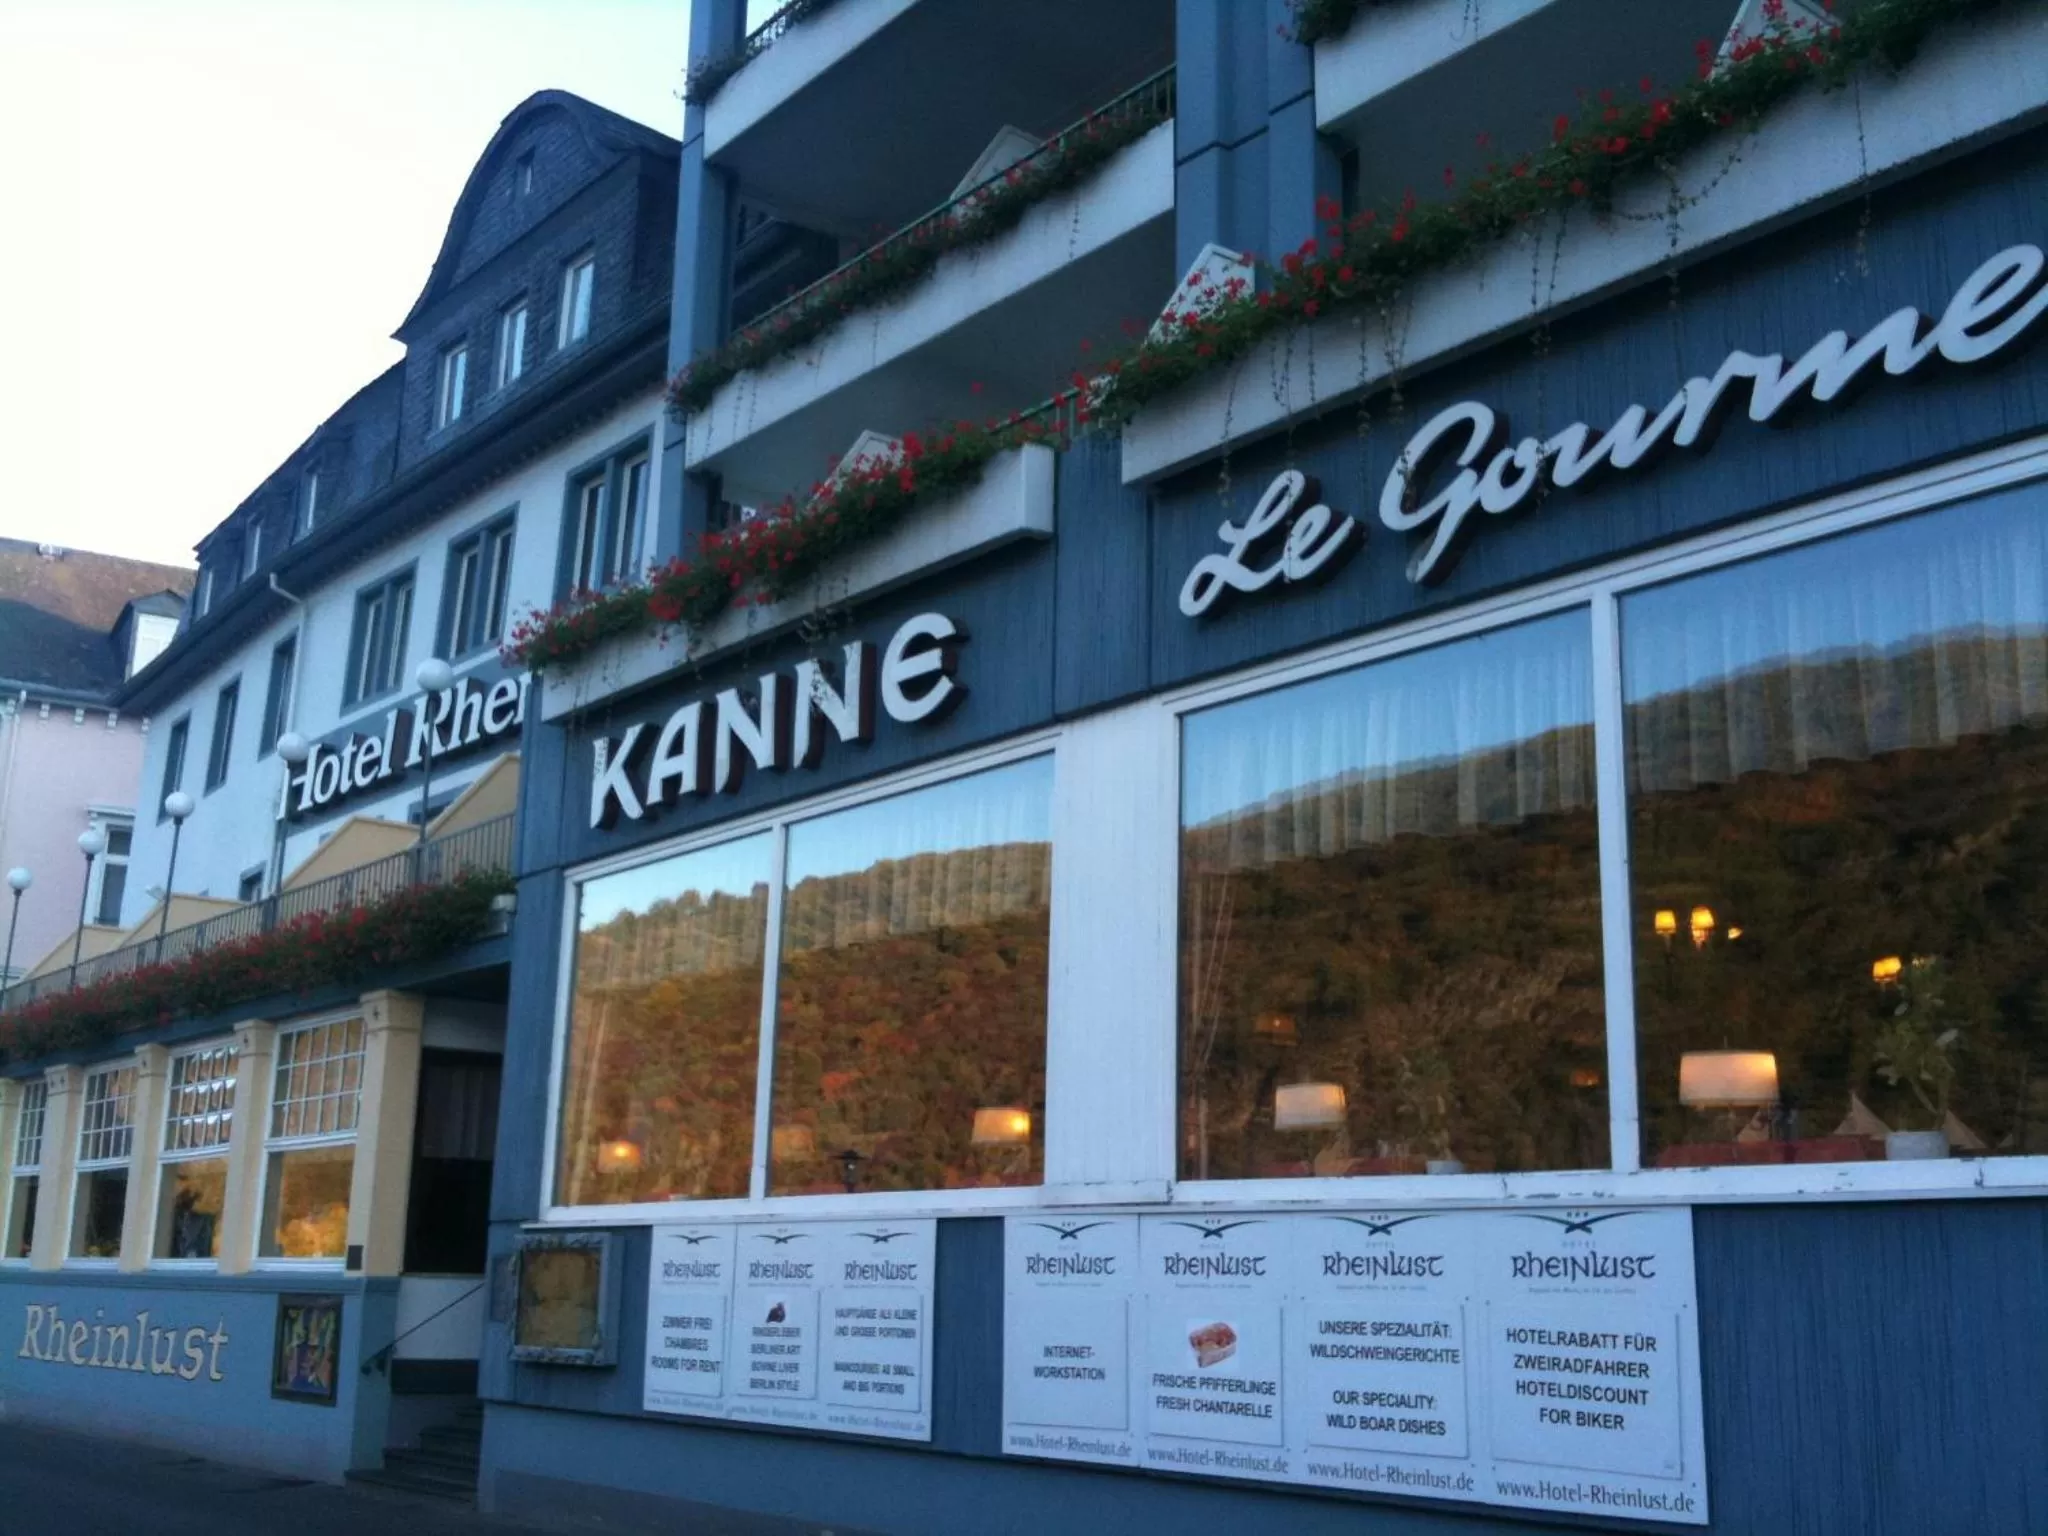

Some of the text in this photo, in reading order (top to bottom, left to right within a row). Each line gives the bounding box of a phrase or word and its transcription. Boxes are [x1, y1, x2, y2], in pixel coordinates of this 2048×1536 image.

[1179, 469, 1354, 618] Le
[590, 612, 957, 829] KANNE
[276, 708, 399, 821] Hotel
[1319, 1320, 1368, 1336] UNSERE
[1506, 1327, 1657, 1352] HOTELRABATT FÜR
[18, 1303, 229, 1382] Rheinlust
[1310, 1344, 1460, 1364] WILDSCHWEINGERICHTE
[681, 1358, 697, 1371] FOR
[699, 1360, 721, 1374] RENT
[1033, 1365, 1105, 1381] WORKSTATION
[1513, 1353, 1650, 1379] ZWEIRADFAHRER
[777, 1379, 800, 1391] STYLE
[1152, 1373, 1277, 1396] FRISCHE PFIFFERLINGE
[1515, 1380, 1650, 1405] HOTELDISCOUNT
[1156, 1395, 1273, 1419] FRESH CHANTARELLE
[1333, 1390, 1360, 1405] OUR
[1326, 1414, 1446, 1436] WILD BOAR DISHES
[1539, 1407, 1625, 1431] FOR BIKER
[1148, 1446, 1289, 1475] www.Hotel-Rheinlust.de
[1307, 1461, 1475, 1492] www.Hotel-Rheinlust.de
[1496, 1479, 1695, 1513] www.Hotel-Rheinlust.de
